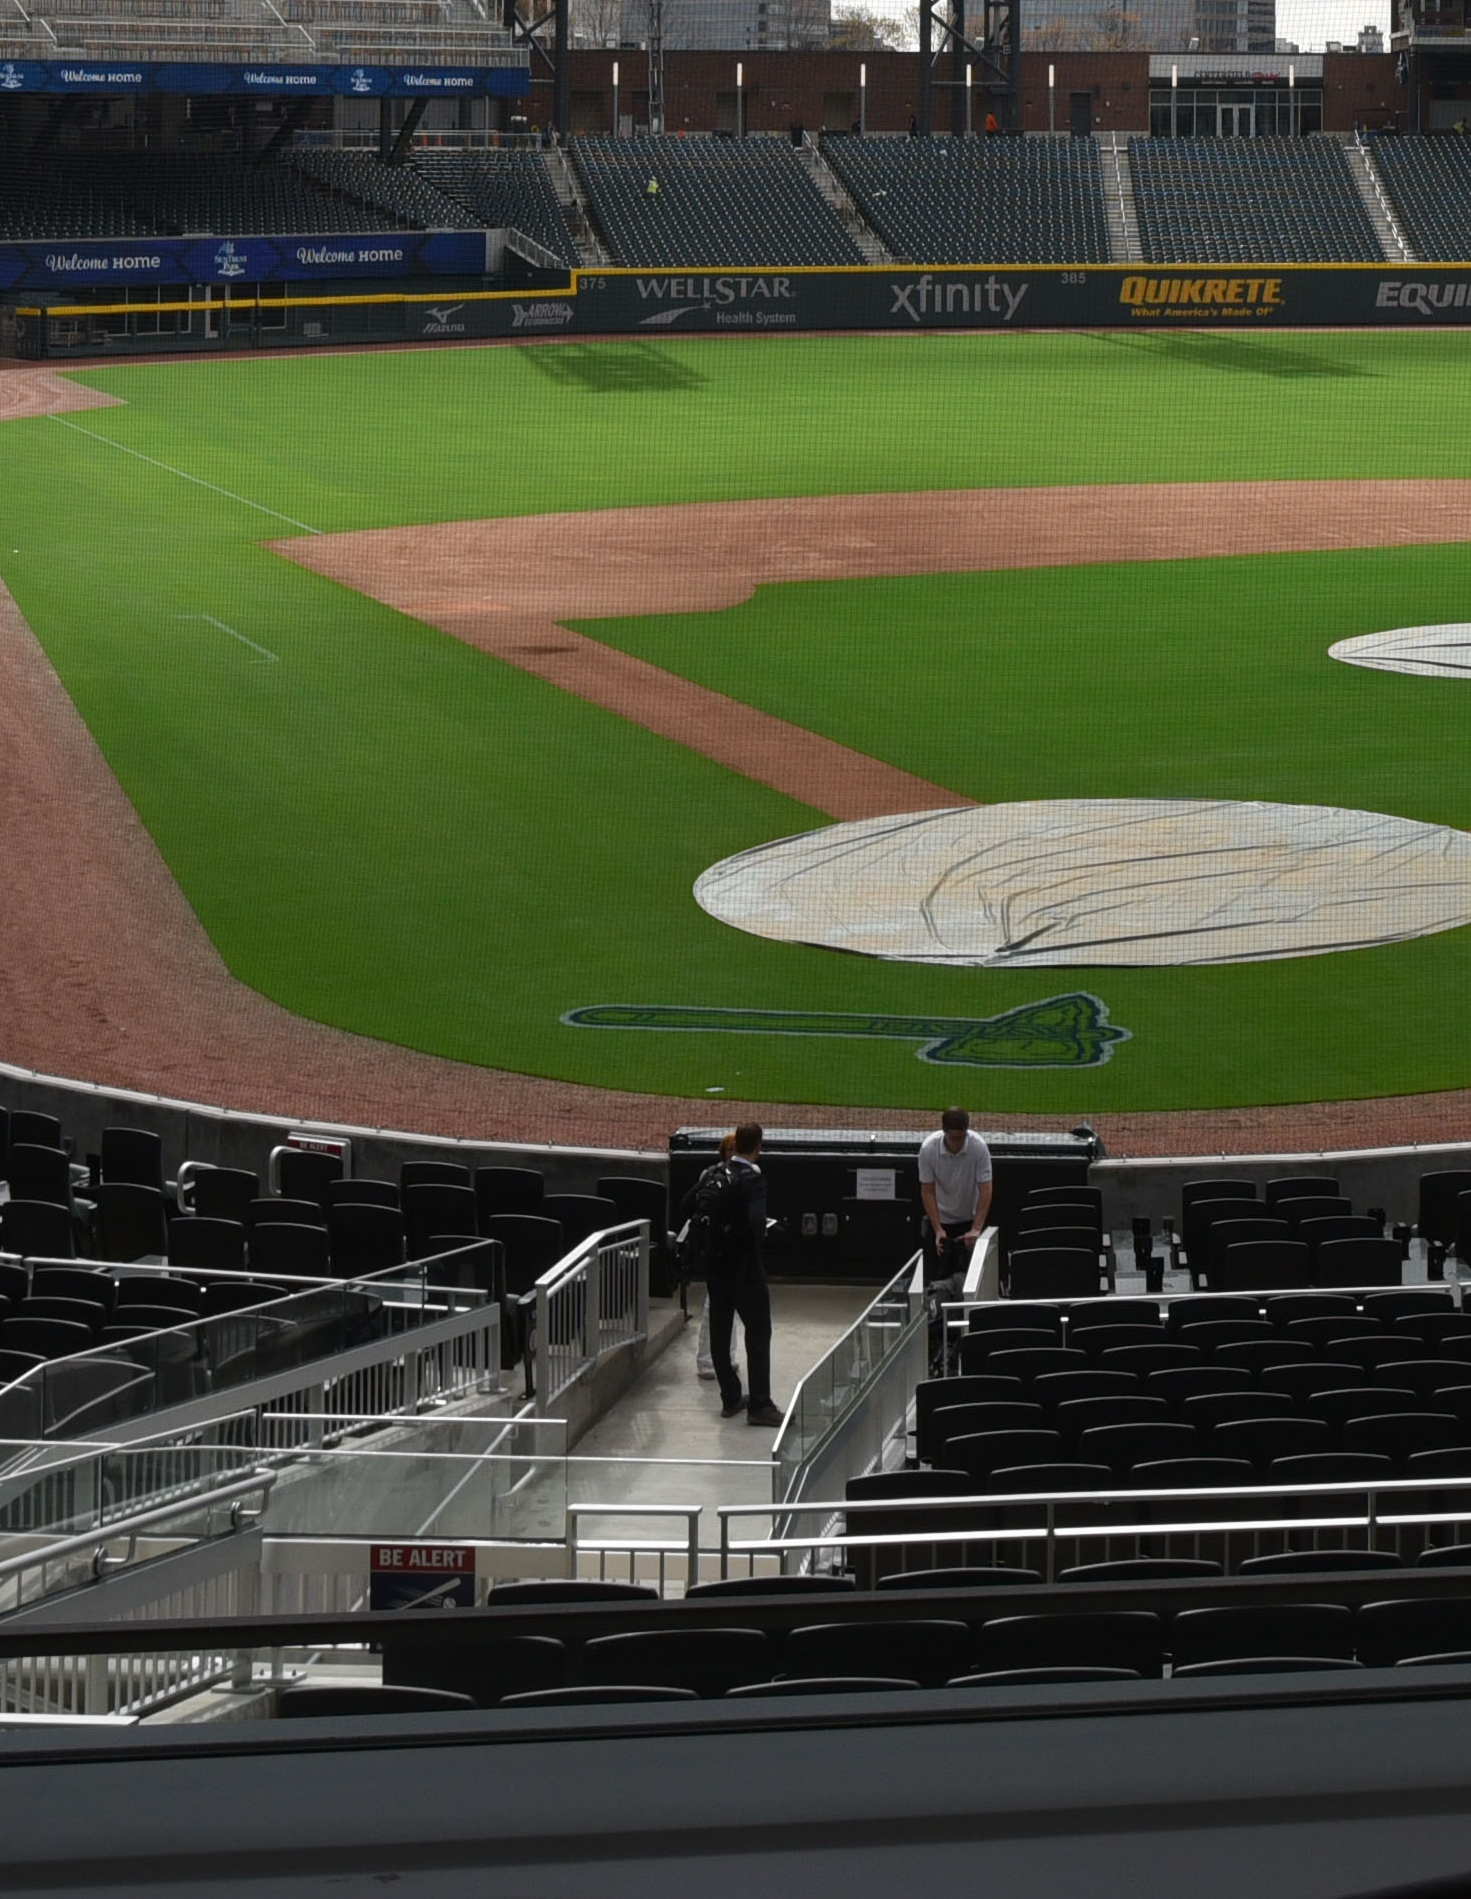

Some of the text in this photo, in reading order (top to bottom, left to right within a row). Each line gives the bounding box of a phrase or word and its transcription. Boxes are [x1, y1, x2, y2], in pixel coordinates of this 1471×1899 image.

[60, 68, 106, 83] Welcome
[243, 70, 284, 85] Welcome
[403, 72, 442, 87] Welcome
[45, 252, 110, 273] Welcome
[296, 245, 356, 266] Welcome
[579, 277, 607, 290] 375
[1060, 272, 1087, 285] 385
[636, 277, 793, 305] WELLSTAR
[889, 274, 1029, 322] xfinity
[1119, 275, 1282, 306] QUIKRETE
[716, 310, 797, 326] Health System
[1131, 308, 1161, 318] What
[1164, 308, 1218, 319] America's
[1222, 308, 1253, 318] Made
[378, 1548, 466, 1568] BE ALERT
